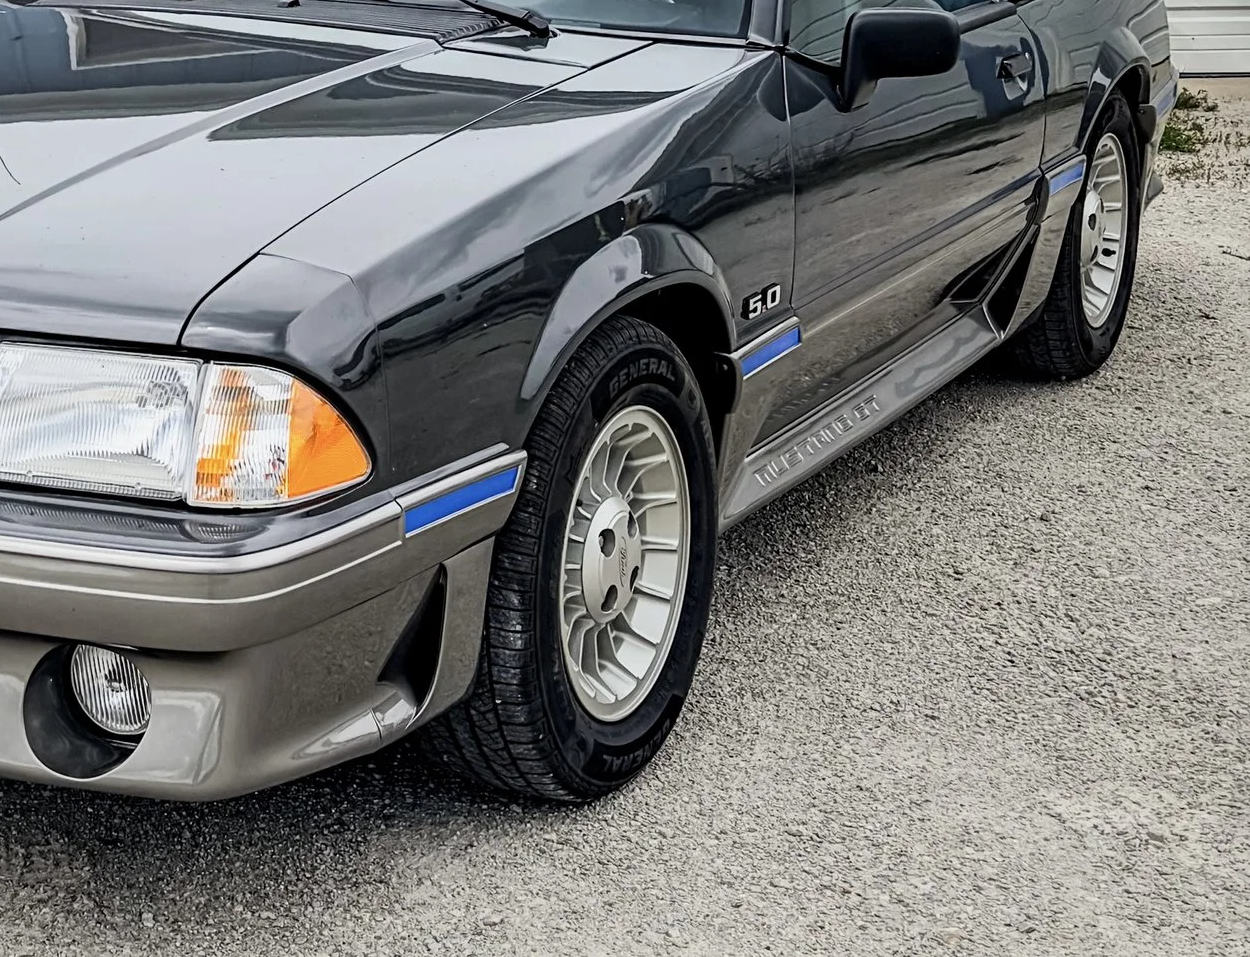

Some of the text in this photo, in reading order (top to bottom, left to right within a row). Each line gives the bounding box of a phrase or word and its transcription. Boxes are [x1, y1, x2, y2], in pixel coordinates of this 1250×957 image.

[747, 284, 781, 320] 5.0
[609, 357, 676, 399] GENERAL
[752, 413, 854, 488] MUSTANG
[852, 394, 880, 421] GT
